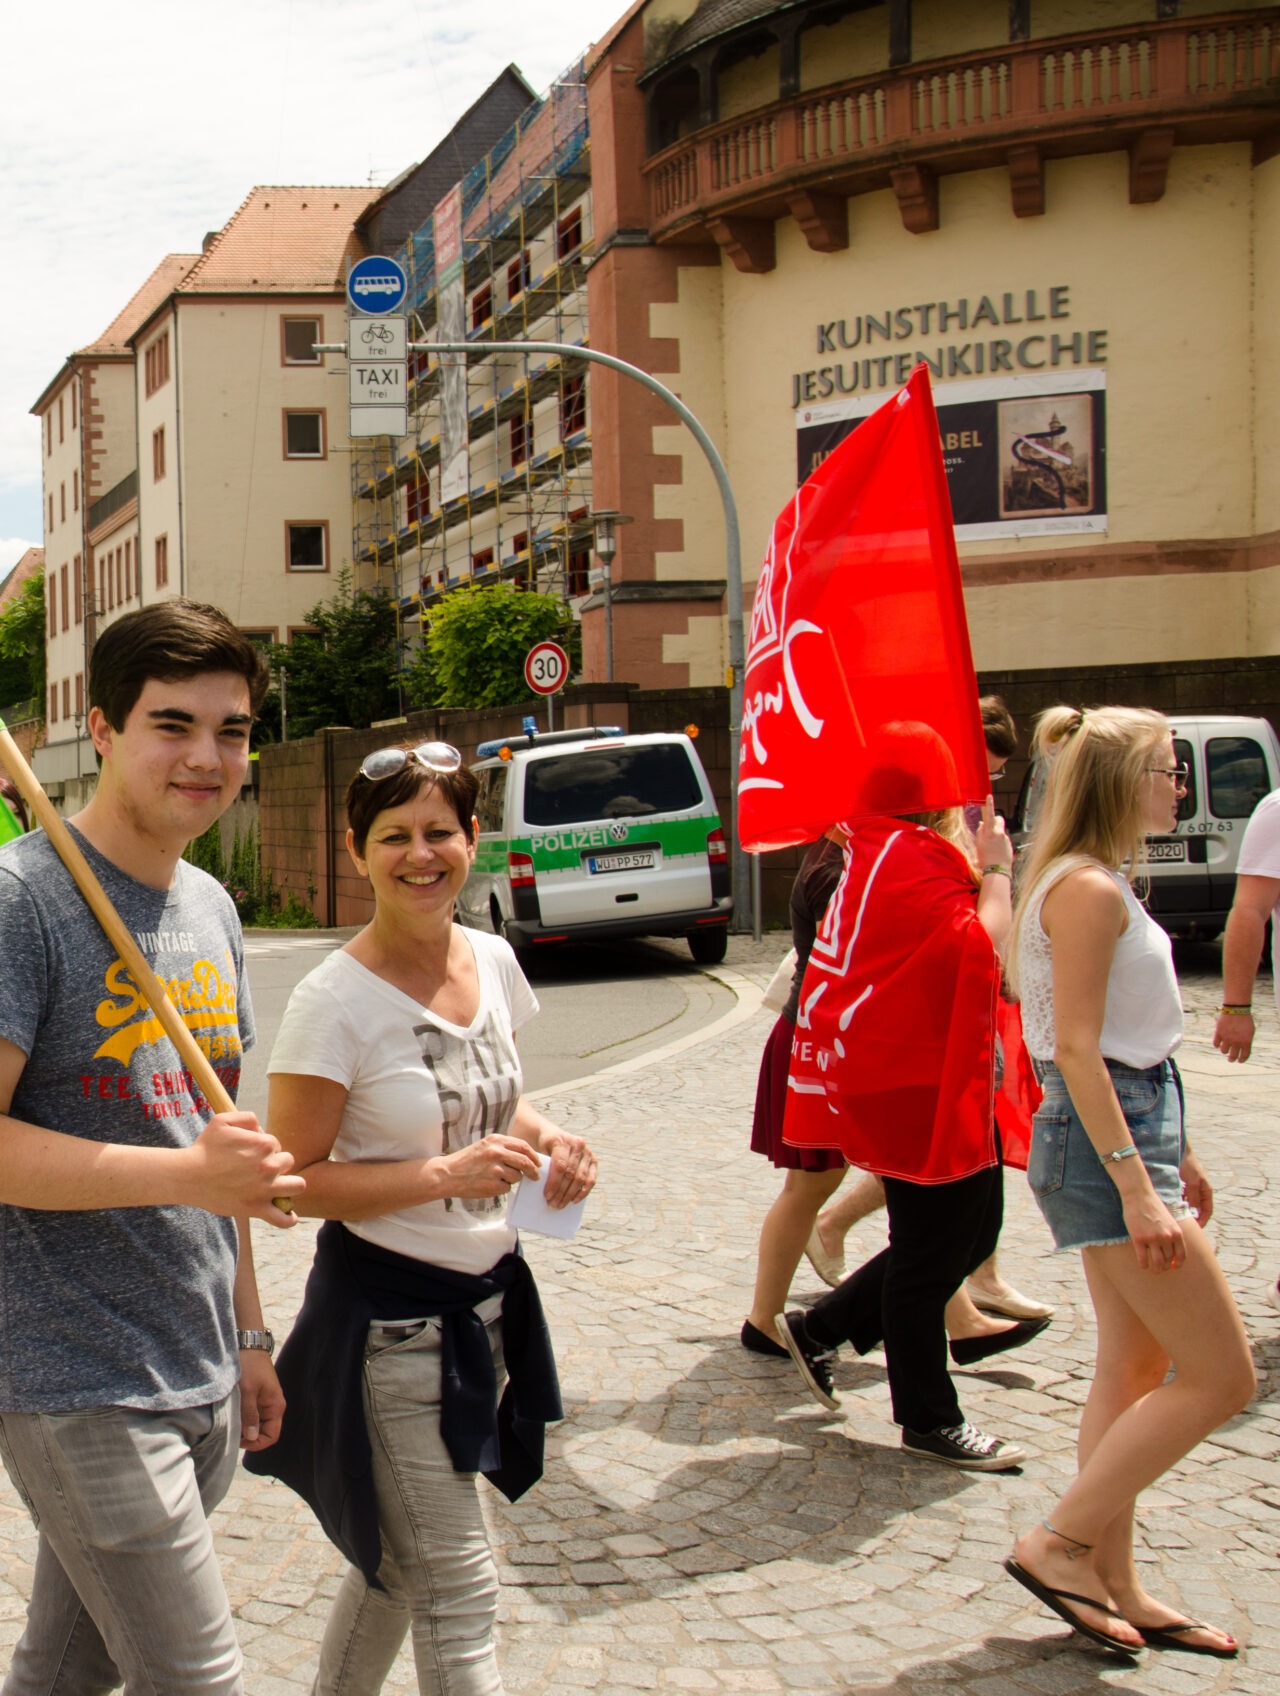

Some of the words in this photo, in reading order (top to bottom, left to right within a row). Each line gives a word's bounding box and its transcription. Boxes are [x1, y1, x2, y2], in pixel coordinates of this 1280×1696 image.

[816, 285, 1070, 354] KUNSTHALLE
[368, 346, 387, 355] frei
[356, 369, 399, 385] TAXI
[792, 330, 1108, 409] JESUITENKIRCHE
[369, 389, 388, 398] frei
[534, 656, 559, 681] 30
[531, 829, 609, 853] POLIZEI
[1148, 844, 1181, 858] 2020
[617, 856, 631, 867] PP
[633, 854, 652, 866] 577
[137, 932, 195, 953] VINTAGE
